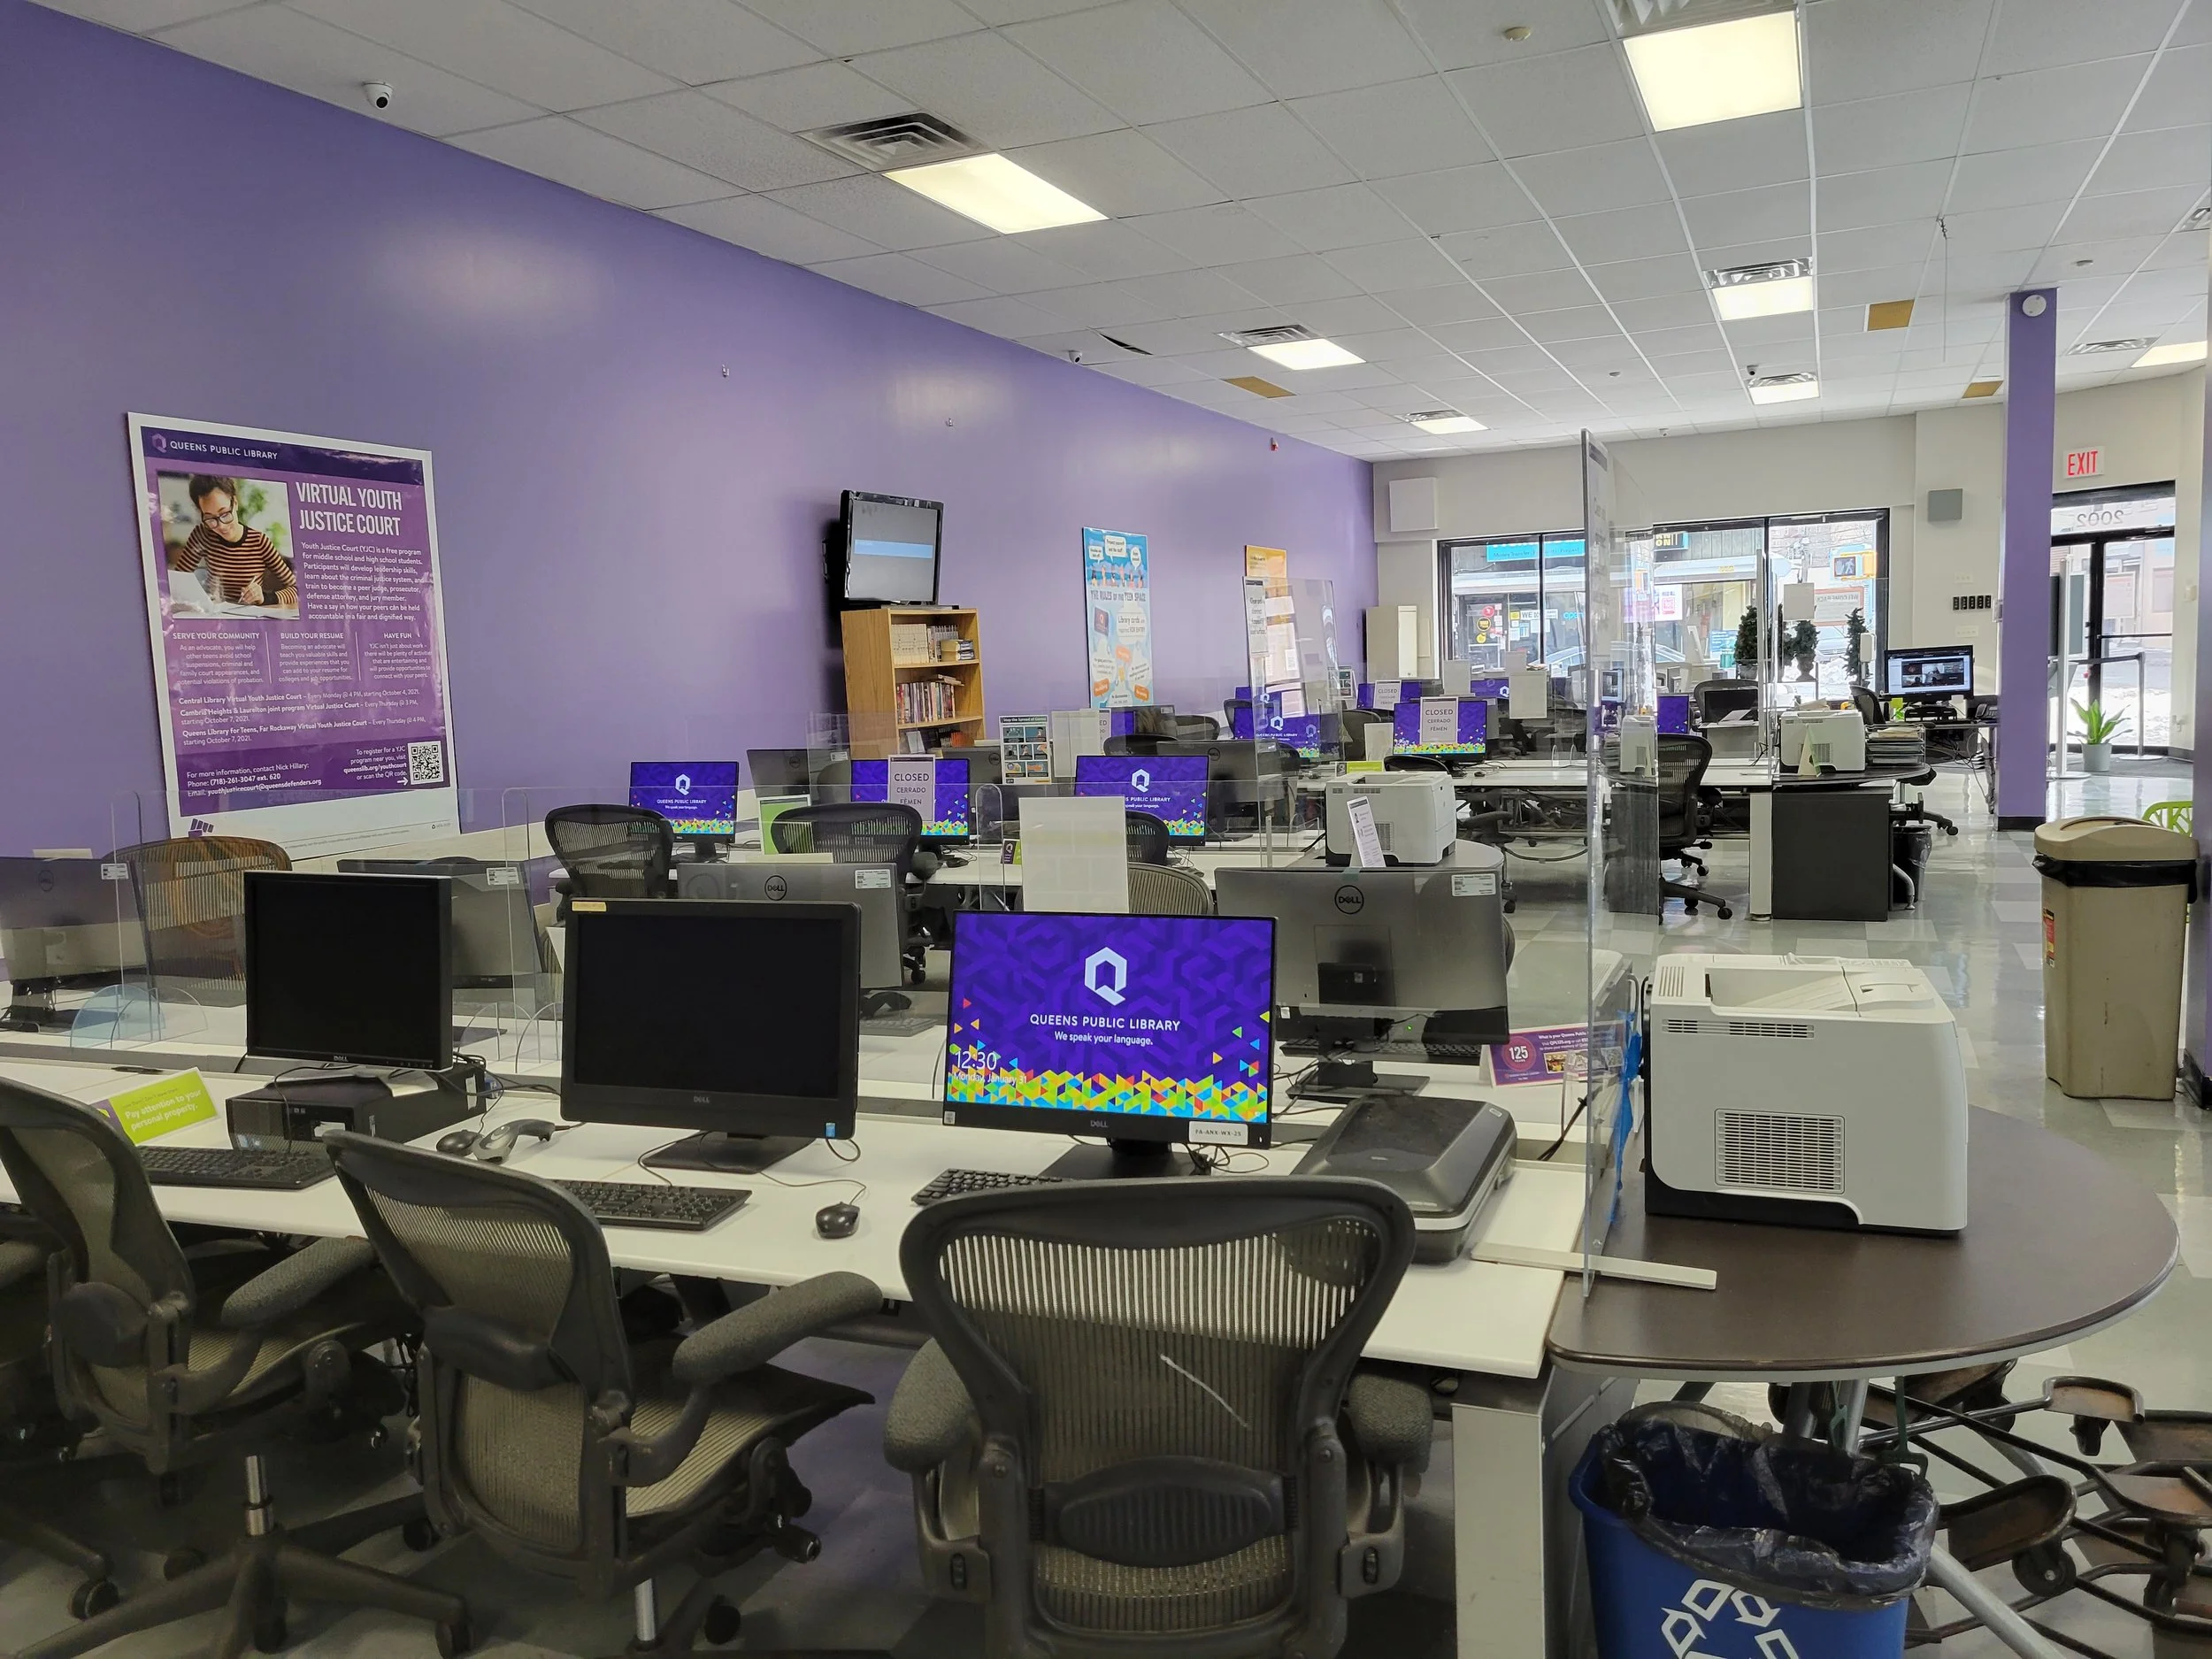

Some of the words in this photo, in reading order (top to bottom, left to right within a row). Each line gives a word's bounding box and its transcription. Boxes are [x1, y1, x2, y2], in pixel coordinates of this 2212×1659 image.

[170, 441, 207, 452] QUEENS
[211, 445, 241, 456] PUBLIC
[244, 449, 278, 459] LIBRARY
[2068, 451, 2098, 476] EXIT
[296, 482, 357, 506] VIRTUAL
[357, 488, 402, 511] YOUTH
[300, 510, 355, 533] JUSTICE
[357, 514, 400, 535] COURT
[366, 556, 379, 565] high
[210, 776, 256, 786] (718)-261-3047
[1030, 1014, 1078, 1026] QUEENS
[1083, 1016, 1125, 1028] PUBLIC
[1130, 1018, 1180, 1032] LIBRARY
[1055, 1031, 1067, 1041] We
[1069, 1032, 1092, 1043] speak
[1094, 1034, 1112, 1044] your
[1114, 1034, 1153, 1047] language.
[956, 1051, 996, 1071] 12:30
[1509, 1046, 1528, 1060] 125
[954, 1072, 985, 1082] Monday,
[987, 1073, 1016, 1086] January
[125, 1110, 140, 1118] Pay
[142, 1100, 175, 1114] attention
[186, 1089, 201, 1101] your
[131, 1114, 164, 1131] personal
[165, 1104, 198, 1120] property.
